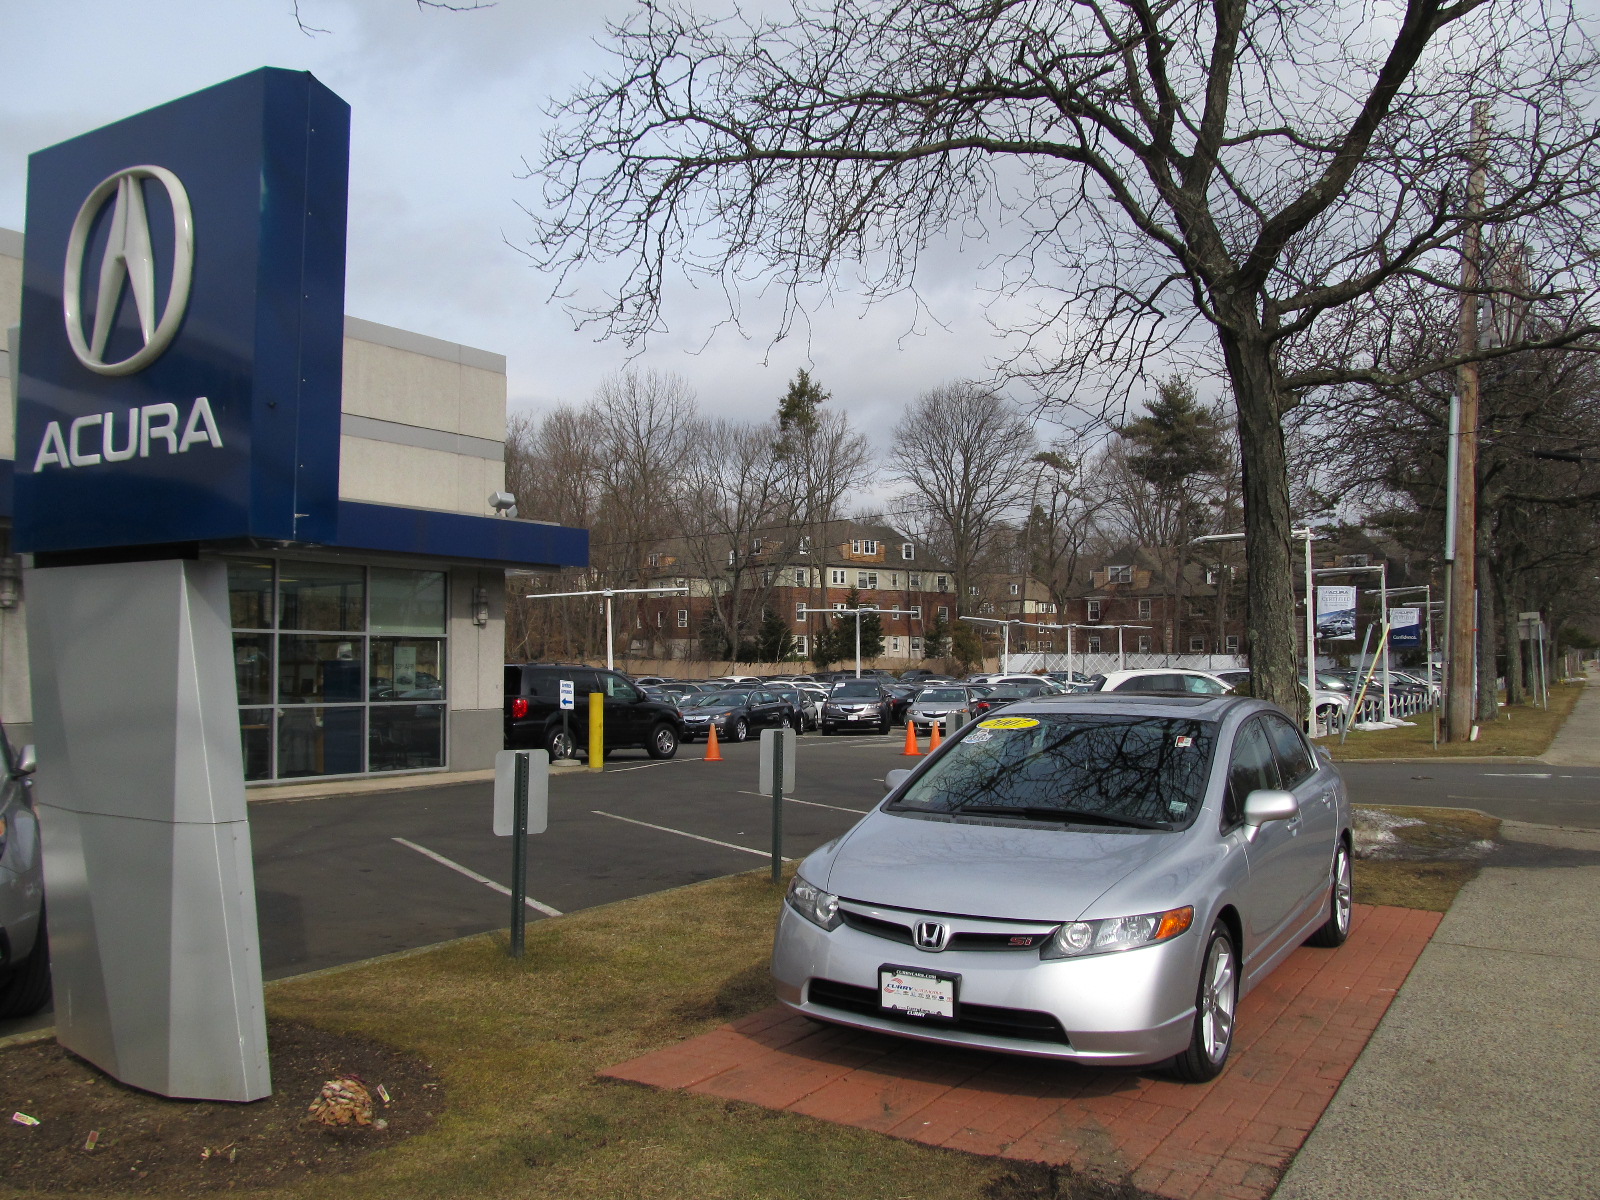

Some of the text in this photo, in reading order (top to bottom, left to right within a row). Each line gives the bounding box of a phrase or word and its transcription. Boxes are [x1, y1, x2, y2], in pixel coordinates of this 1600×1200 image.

[33, 397, 223, 473] ACURA
[1008, 936, 1033, 946] Si
[886, 983, 914, 991] CURRY
[906, 1010, 926, 1018] CURRY
